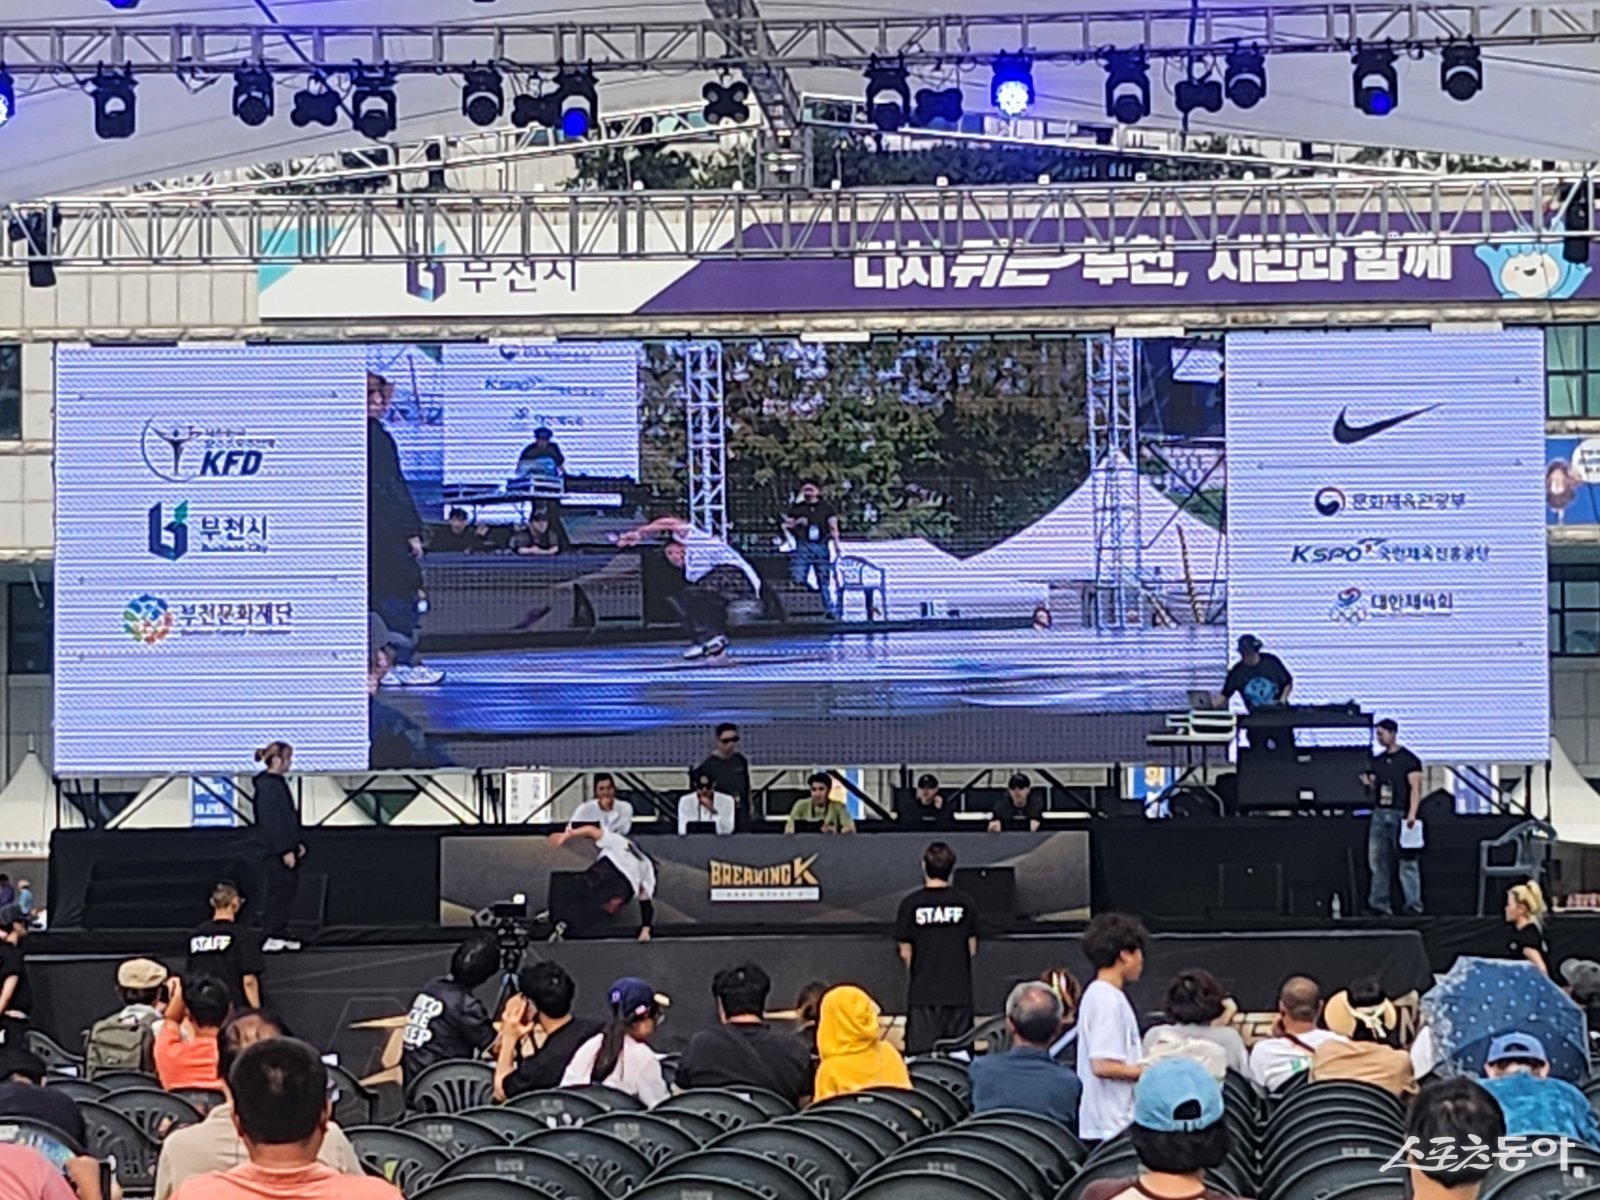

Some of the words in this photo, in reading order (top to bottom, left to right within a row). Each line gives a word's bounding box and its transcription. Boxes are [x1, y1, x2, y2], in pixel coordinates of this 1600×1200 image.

[854, 239, 944, 289] 다시
[1208, 233, 1347, 282] 시민과
[1353, 231, 1452, 280] 함께
[201, 450, 263, 476] KFD
[1352, 493, 1466, 511] 문화체육관광부
[200, 514, 267, 541] 부천시
[1290, 545, 1362, 563] KSPO
[1370, 591, 1454, 611] 대한체육회
[180, 602, 293, 626] 부천문화재단
[915, 905, 964, 925] STAFF
